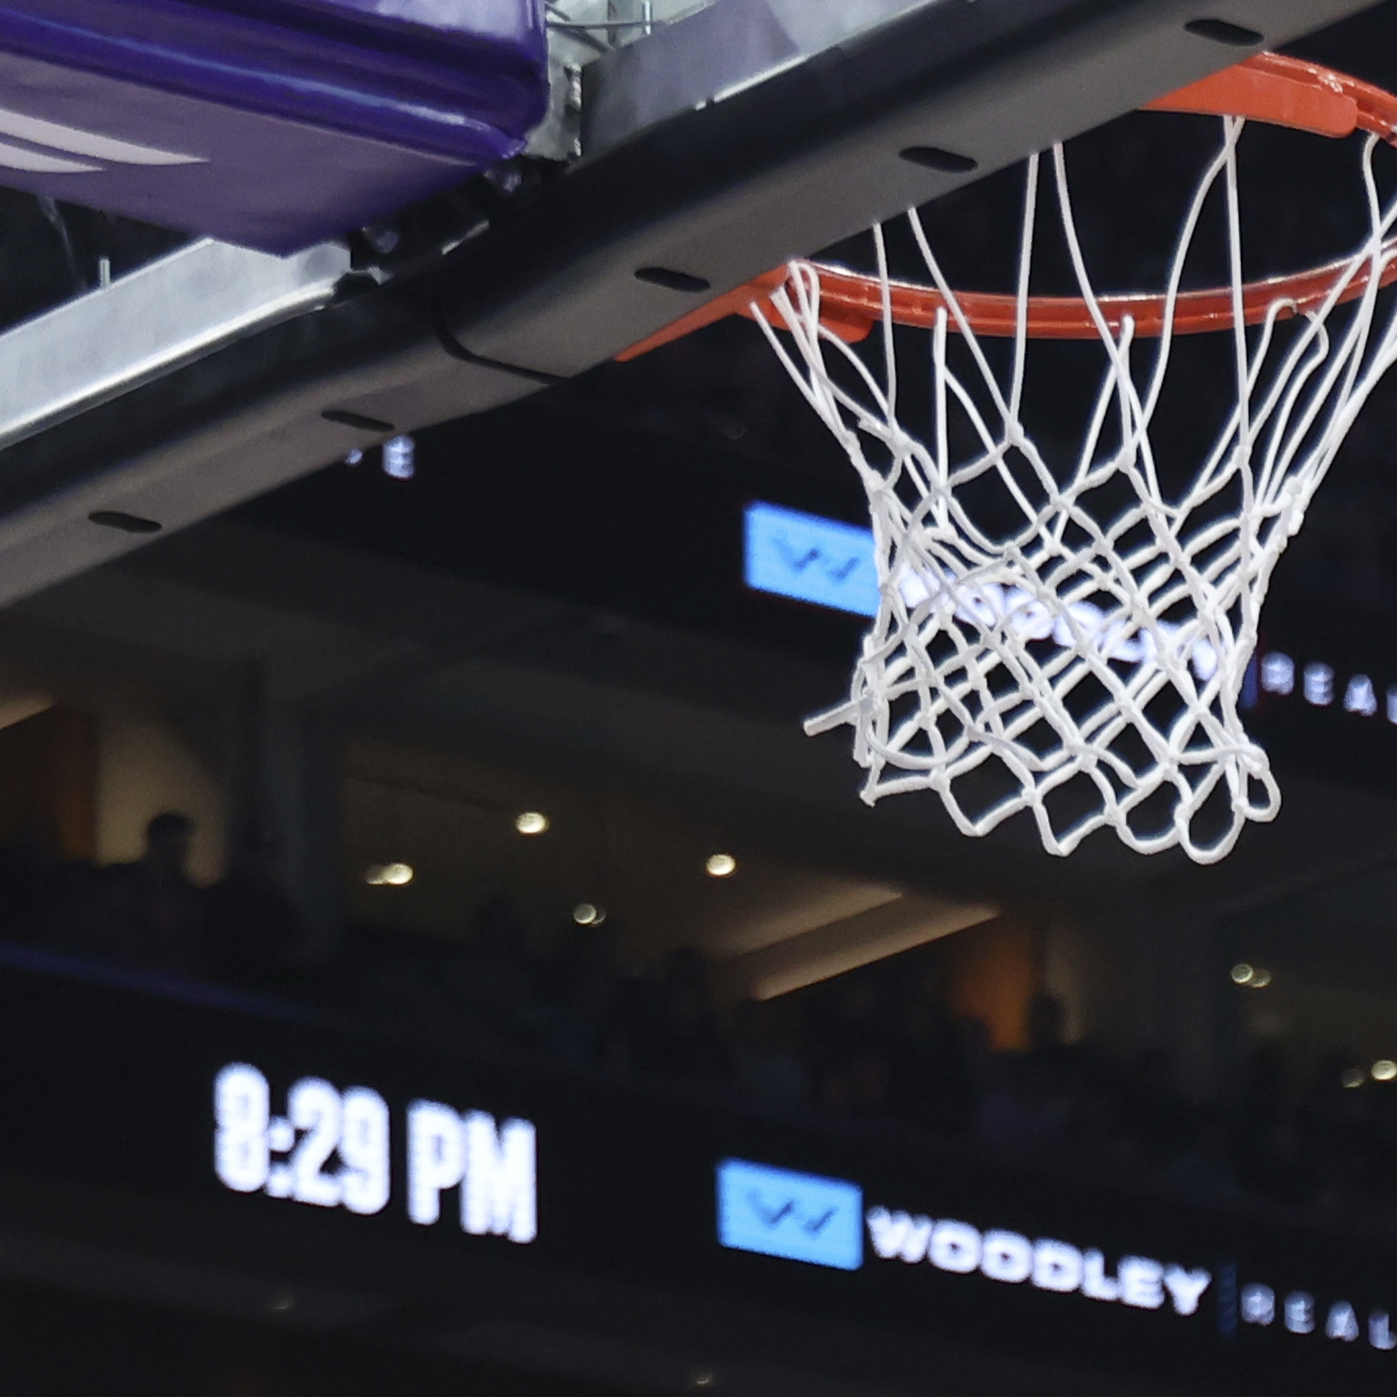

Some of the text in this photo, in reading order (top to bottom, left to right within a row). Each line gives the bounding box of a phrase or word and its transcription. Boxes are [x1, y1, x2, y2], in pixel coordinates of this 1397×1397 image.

[213, 1060, 538, 1244] 8:29 PM
[866, 1205, 1211, 1315] WOODLEY
